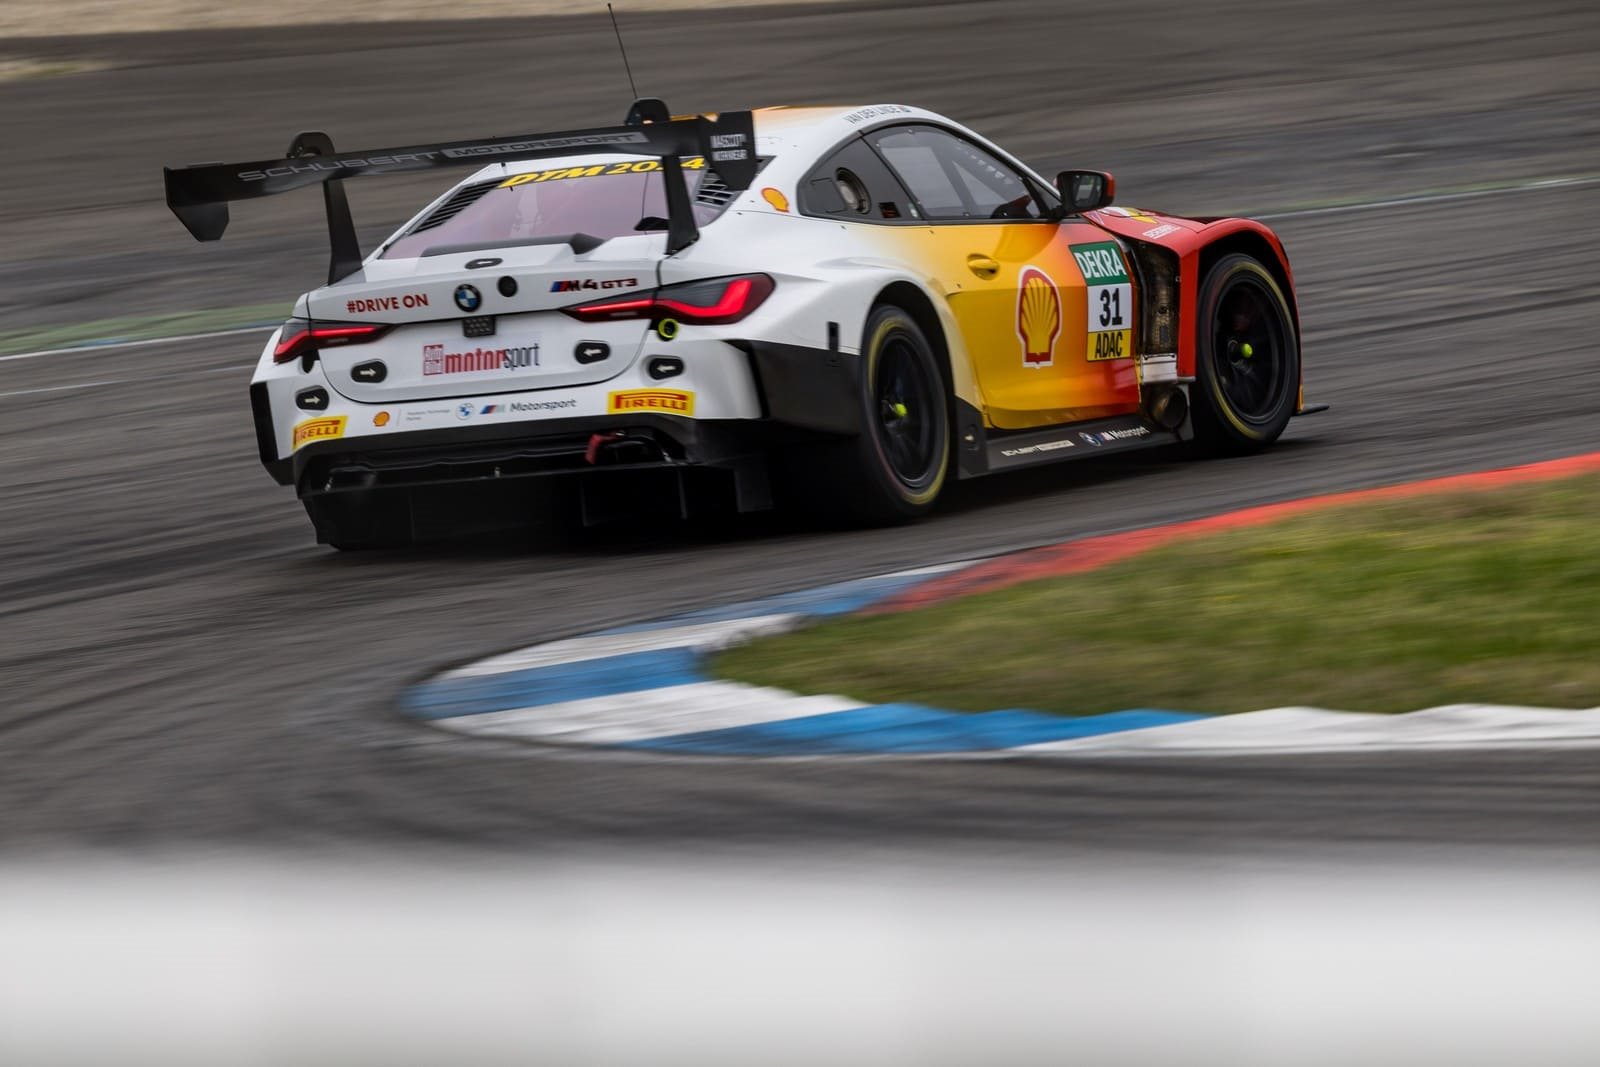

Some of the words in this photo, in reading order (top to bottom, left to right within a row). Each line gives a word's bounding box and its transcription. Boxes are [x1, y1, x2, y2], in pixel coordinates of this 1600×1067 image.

[238, 151, 439, 181] SCHUBERT
[454, 134, 636, 156] MOTORSPORT
[498, 165, 606, 188] DTM
[606, 156, 705, 175] 204
[1073, 248, 1128, 279] DEKRA
[601, 277, 638, 289] GT3
[346, 296, 400, 313] #DRIVE
[402, 293, 429, 308] ON
[1099, 287, 1123, 327] 31
[1094, 332, 1123, 358] ADAC
[510, 399, 577, 413] Motorsport
[614, 391, 688, 411] PIRELLI
